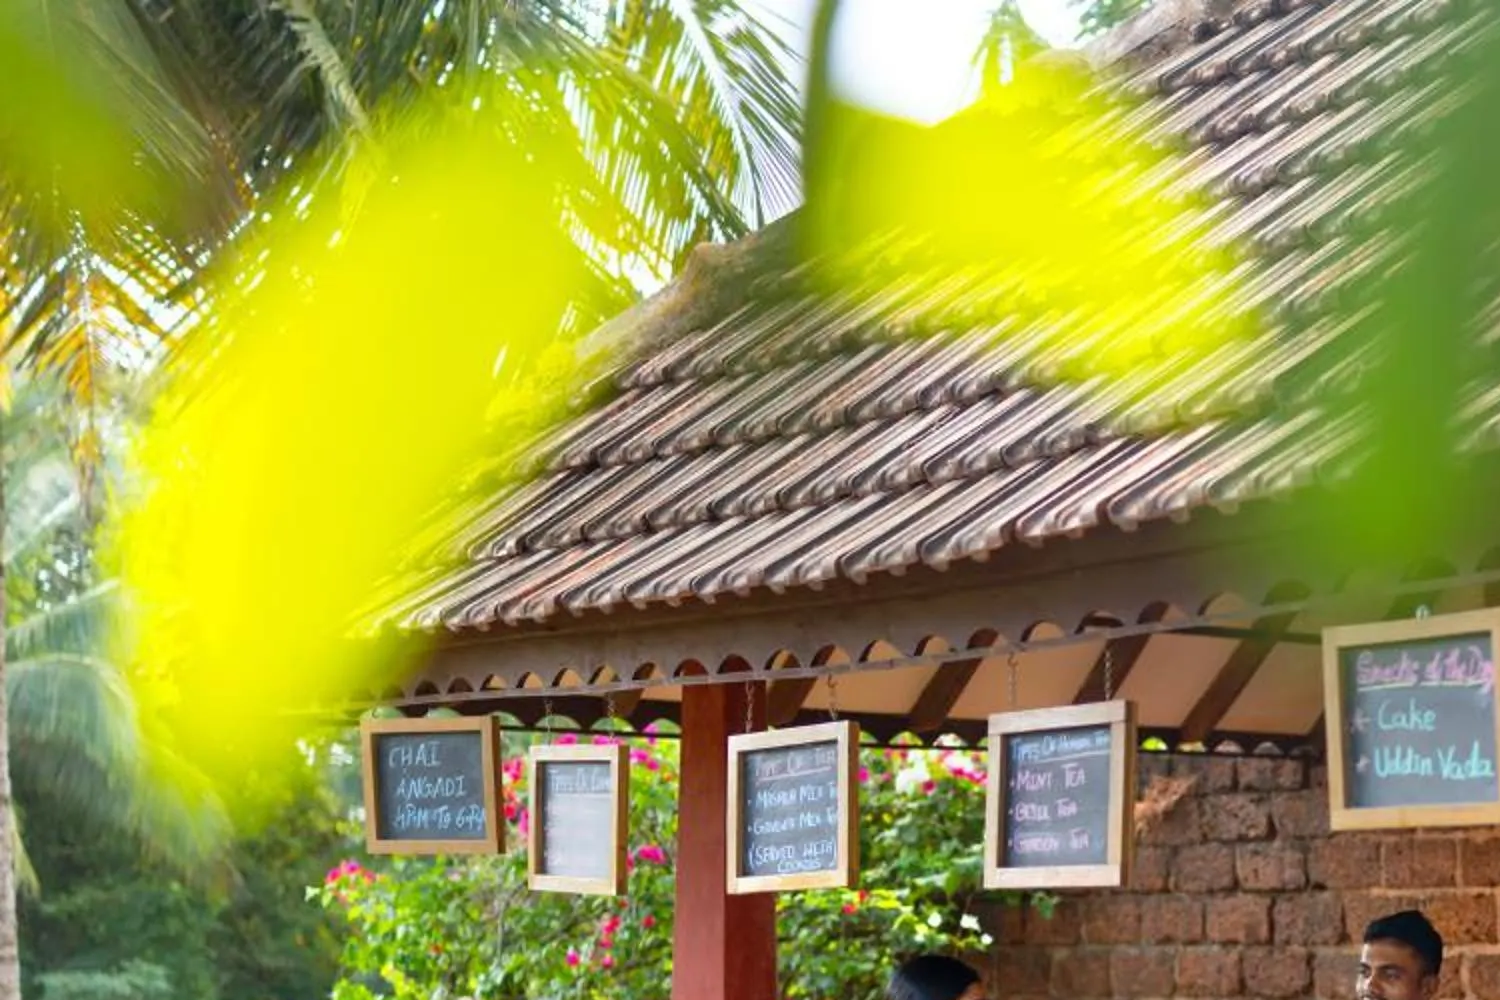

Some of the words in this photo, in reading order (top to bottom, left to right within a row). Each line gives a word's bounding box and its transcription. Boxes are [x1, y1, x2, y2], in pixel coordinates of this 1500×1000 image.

[1378, 698, 1436, 730] Cake
[388, 741, 442, 768] CHAI
[1438, 740, 1495, 780] Vada
[396, 774, 467, 799] ANGADI
[1016, 770, 1052, 791] MINT
[1061, 762, 1086, 789] TEA
